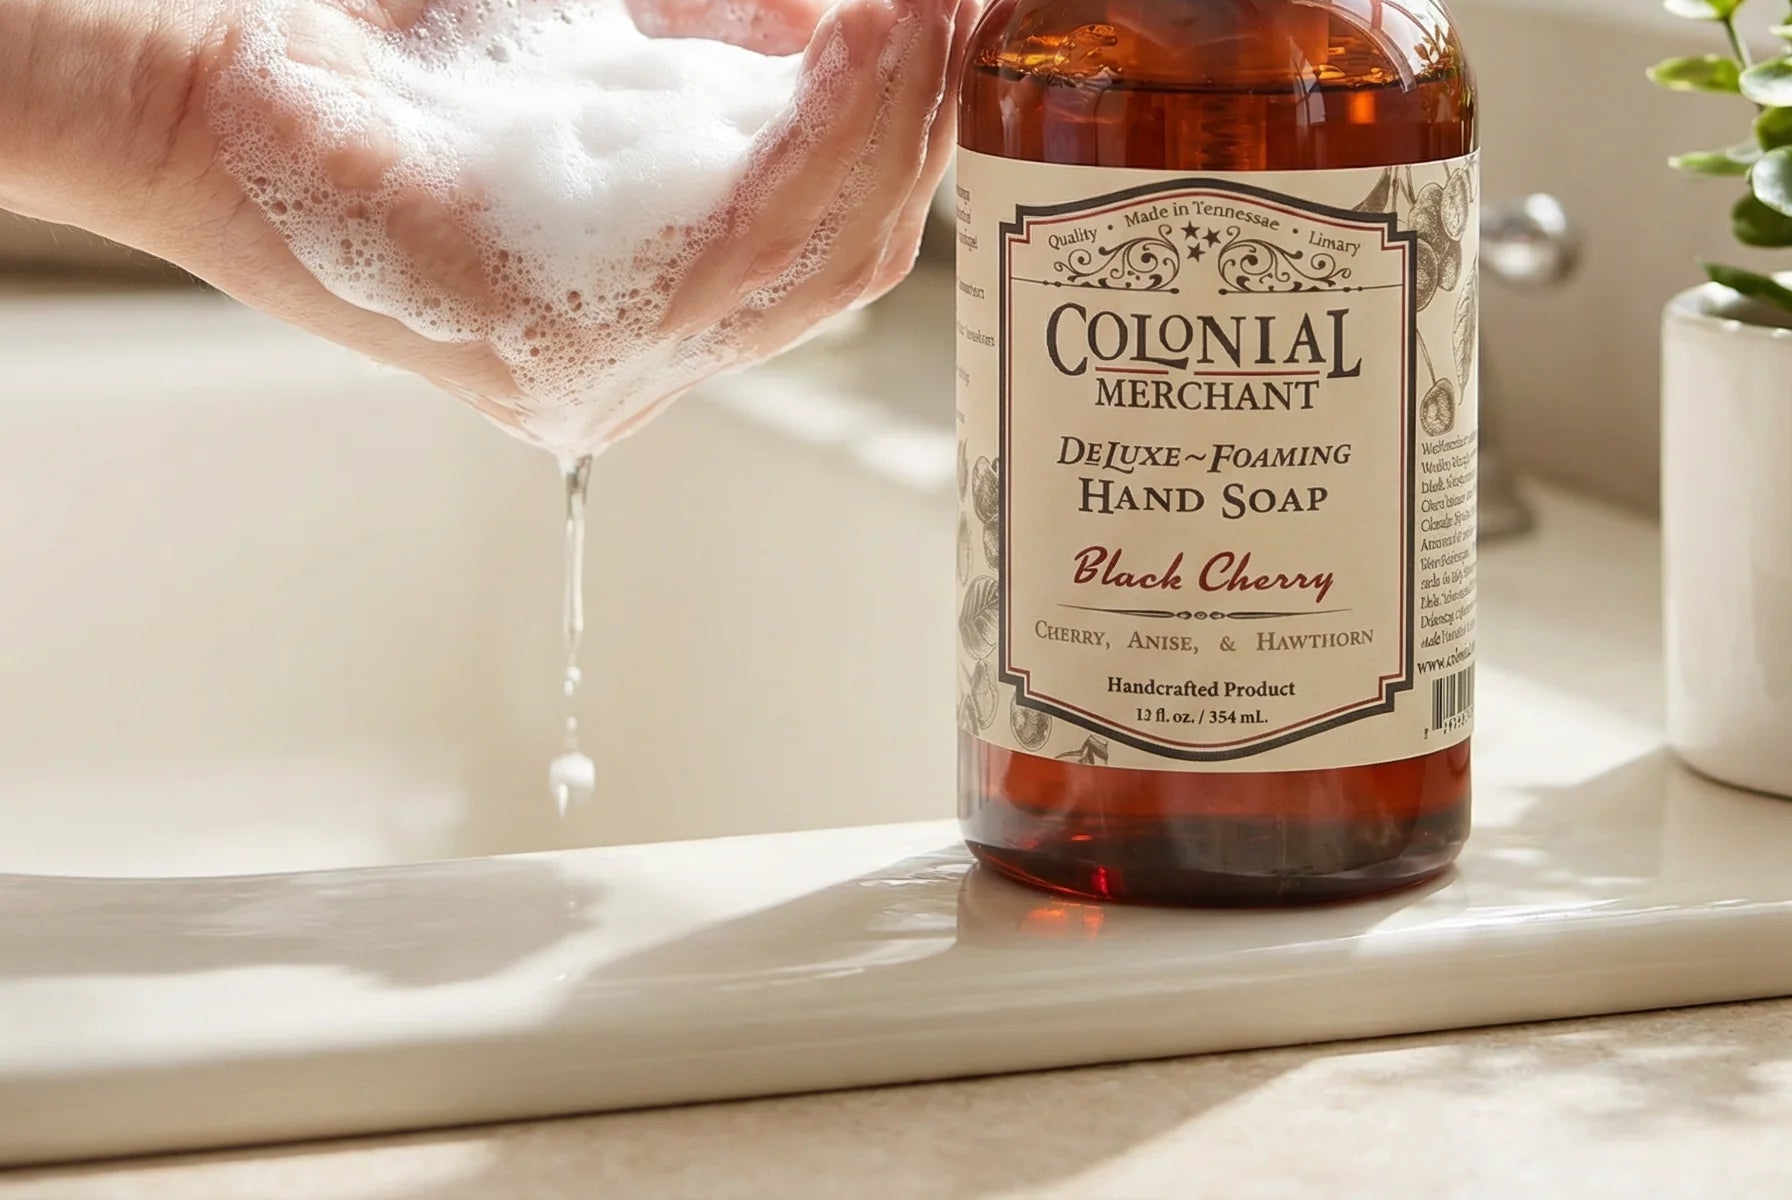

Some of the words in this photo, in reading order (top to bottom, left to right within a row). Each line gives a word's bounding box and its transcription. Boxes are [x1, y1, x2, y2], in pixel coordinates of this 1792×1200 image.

[1048, 227, 1098, 249] Quality
[1123, 203, 1169, 228] Made
[1173, 201, 1189, 216] in
[1046, 301, 1362, 380] COLONIAL
[1094, 377, 1320, 411] MERCHANT
[1077, 476, 1205, 514] HAND
[1221, 482, 1329, 520] SOAP
[1073, 545, 1183, 591] Black
[1198, 550, 1334, 604] Cherry
[1034, 619, 1110, 650] CHERRY,
[1126, 630, 1199, 654] ANISE,
[1219, 635, 1237, 653] &
[1255, 628, 1374, 652] HAWTHORN
[1106, 676, 1220, 697] Handcrafted
[1223, 680, 1296, 698] Product
[1154, 707, 1170, 724] fl.
[1172, 712, 1195, 724] oz.
[1197, 708, 1206, 725] /
[1208, 710, 1237, 724] 354
[1239, 709, 1269, 724] mL.
